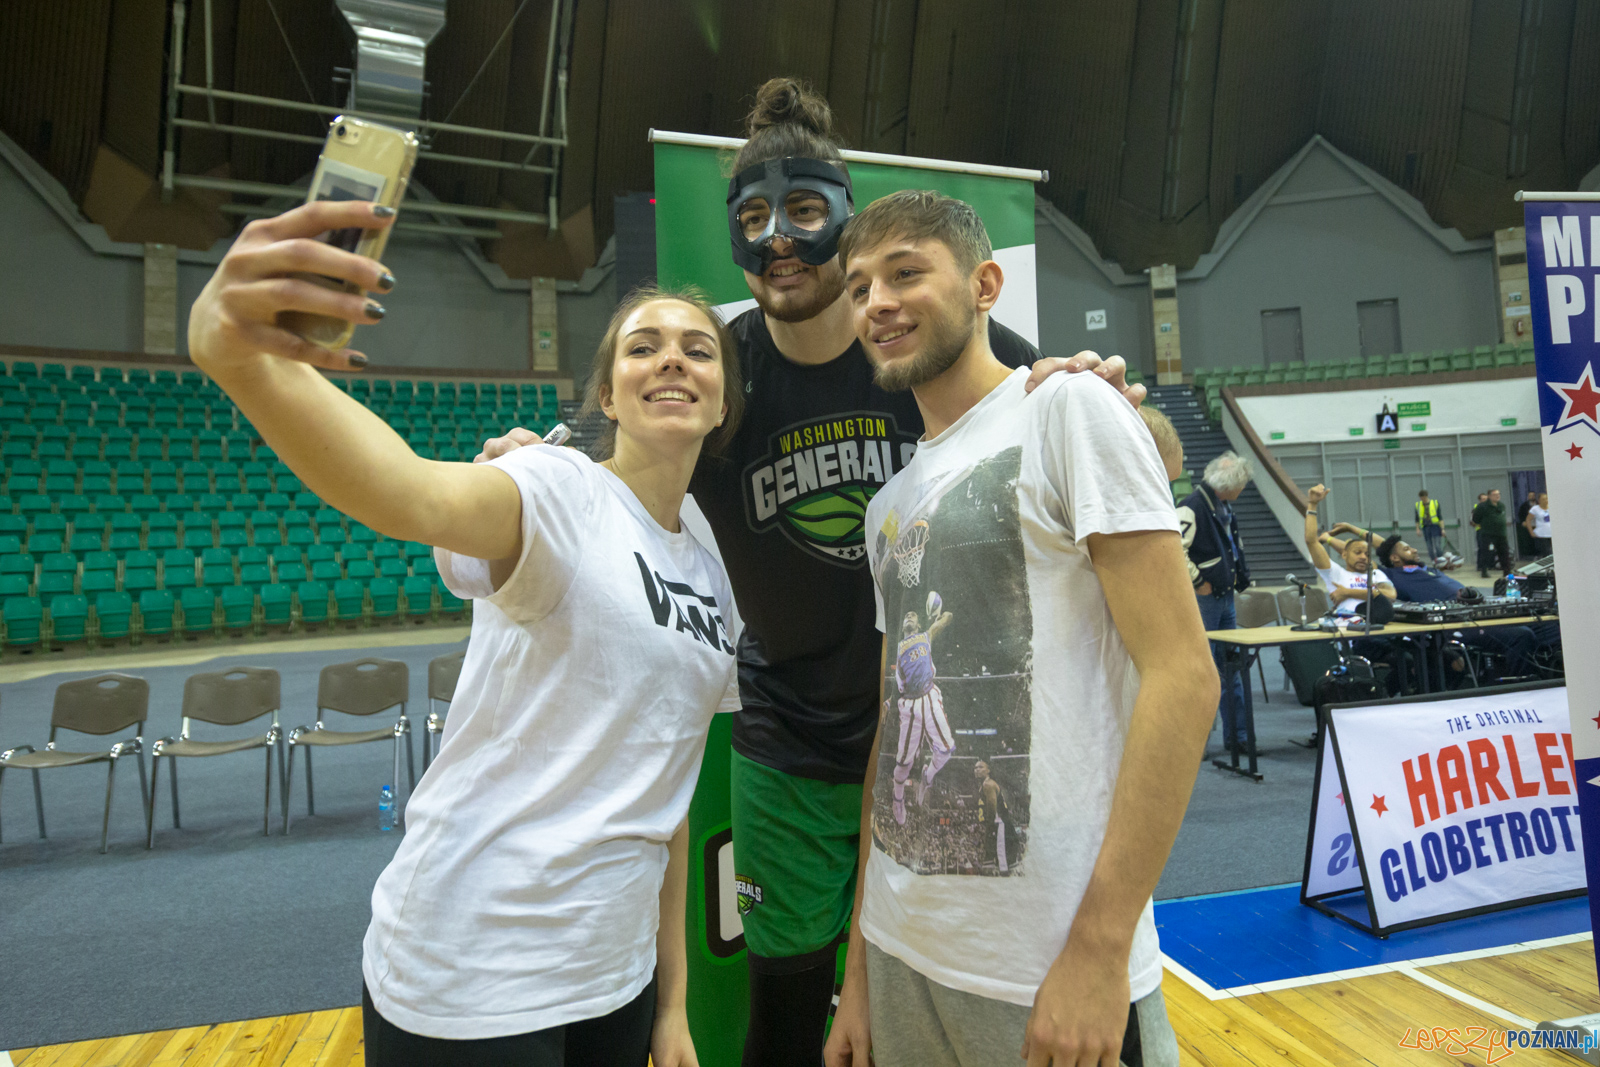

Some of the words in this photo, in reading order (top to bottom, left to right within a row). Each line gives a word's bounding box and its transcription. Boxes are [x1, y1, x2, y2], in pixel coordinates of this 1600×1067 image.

[1088, 314, 1104, 325] A2
[1546, 274, 1600, 345] P
[779, 417, 886, 455] WASHINGTON
[1380, 414, 1396, 431] A
[909, 646, 927, 662] 33
[1446, 715, 1472, 734] THE
[1475, 708, 1543, 728] ORIGINAL
[1401, 732, 1578, 829] HARLE
[1379, 805, 1581, 902] GLOBETROT
